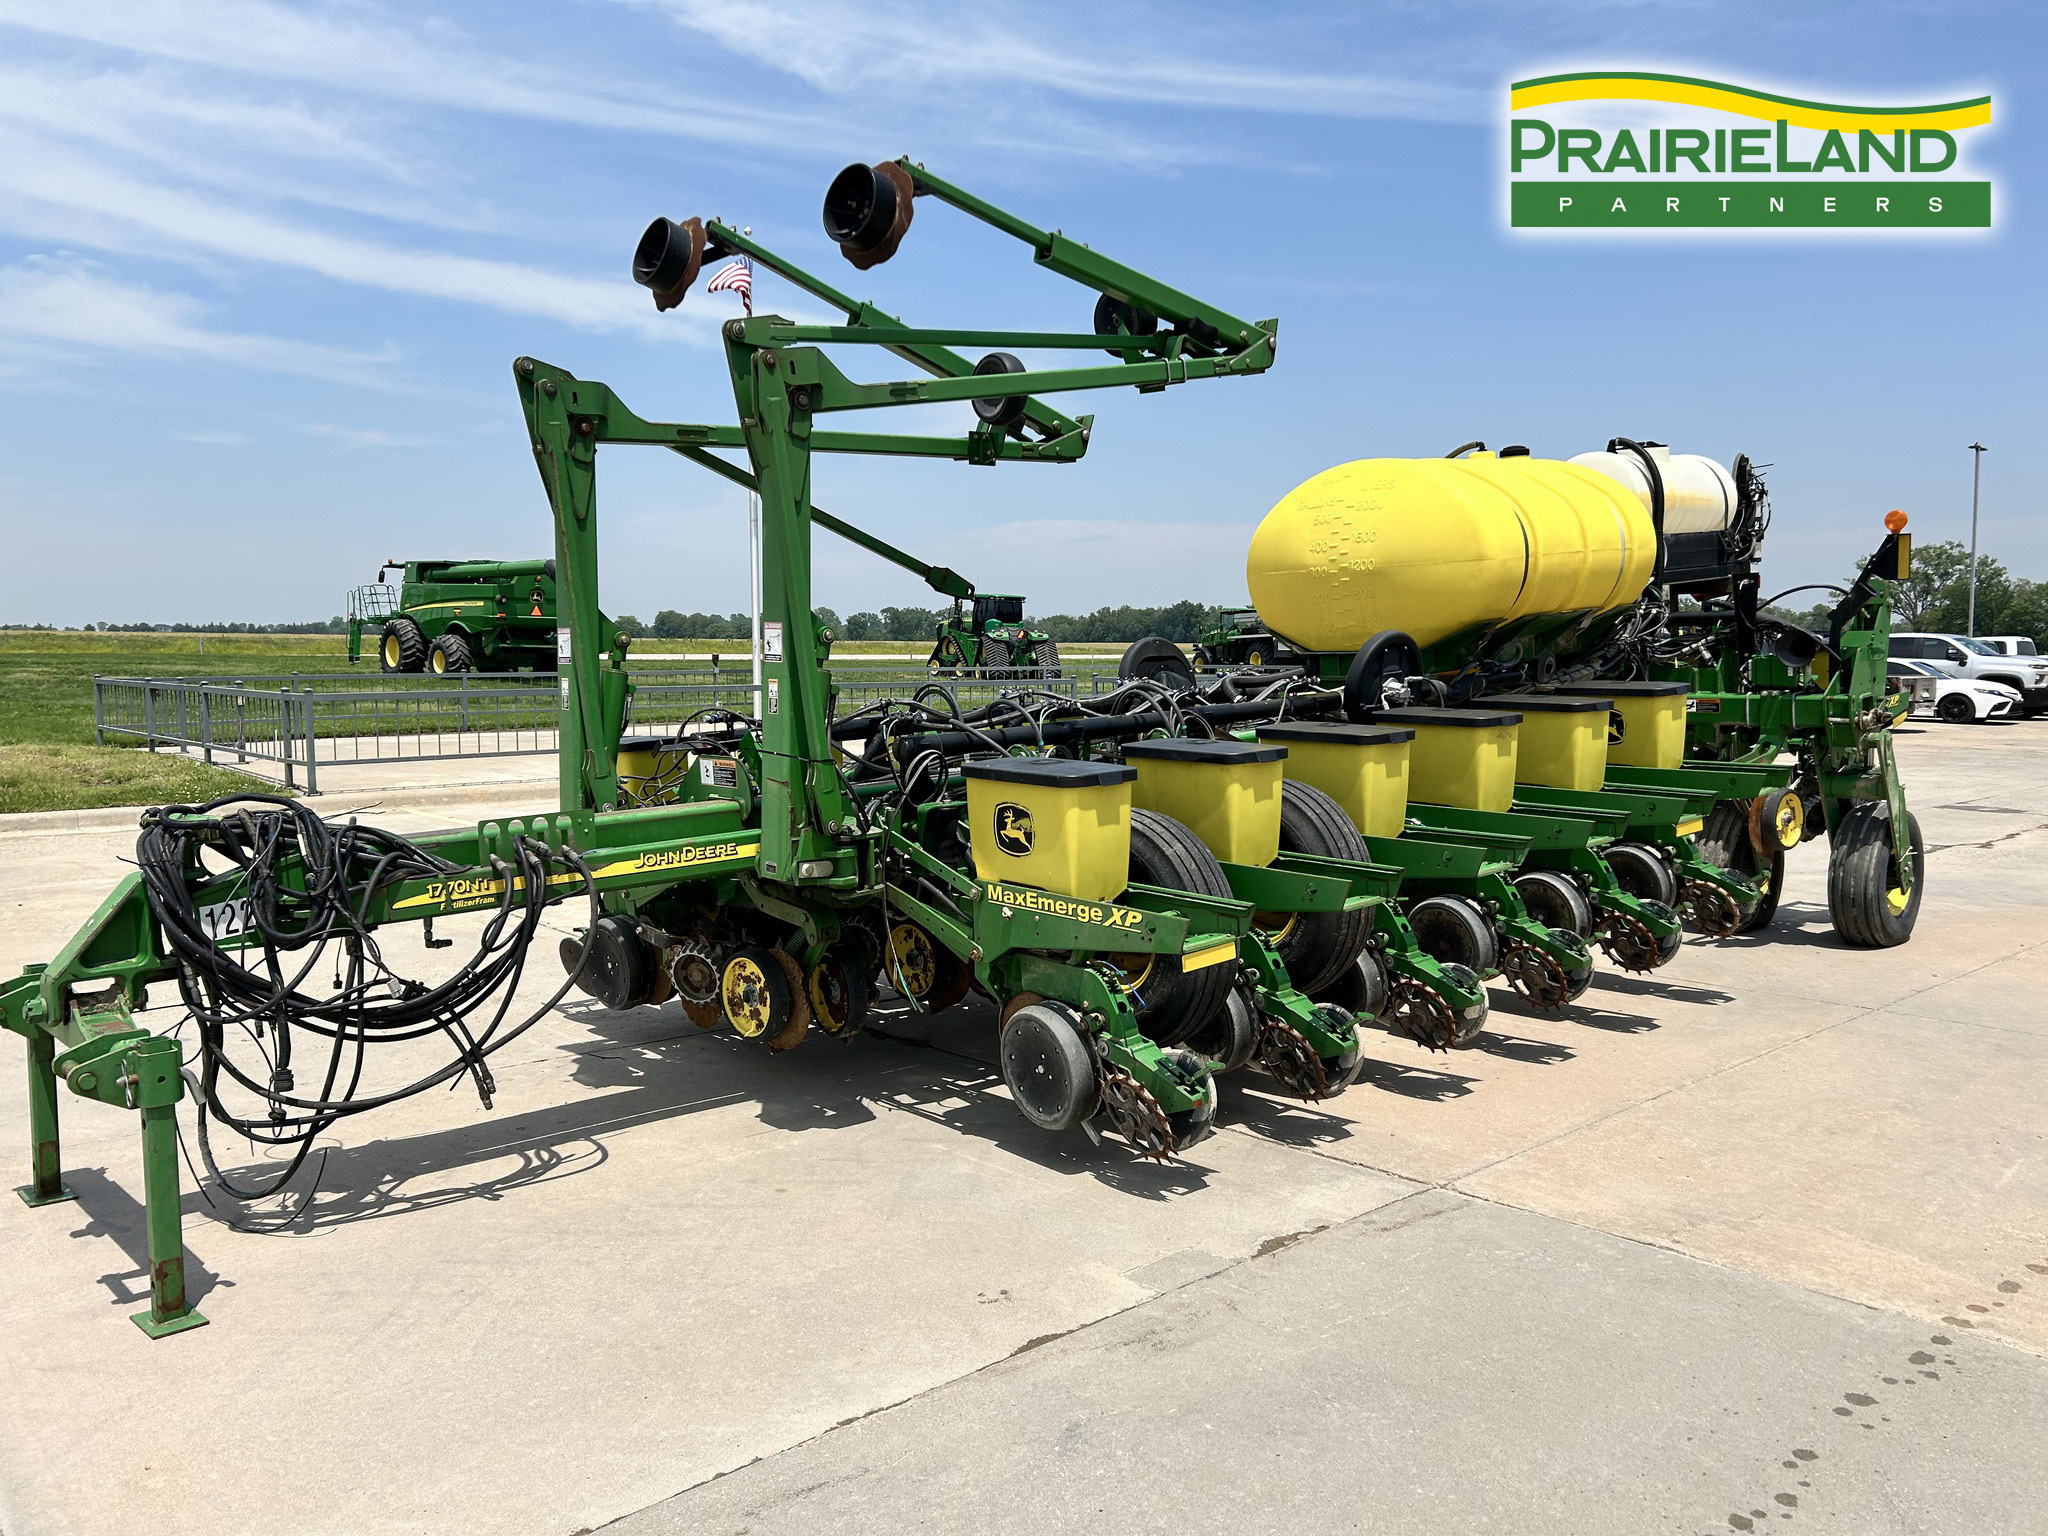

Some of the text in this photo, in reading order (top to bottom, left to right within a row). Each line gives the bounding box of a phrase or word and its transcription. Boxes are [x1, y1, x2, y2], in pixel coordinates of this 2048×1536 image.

[1355, 499, 1384, 511] 2000
[1351, 531, 1377, 543] 1600
[1309, 541, 1328, 554] 400
[1350, 558, 1375, 571] 1200
[1308, 566, 1328, 578] 300
[634, 843, 738, 869] JOHN DEERE
[440, 897, 496, 911] FtilizerFram
[987, 884, 1144, 927] MaxEmerge XP
